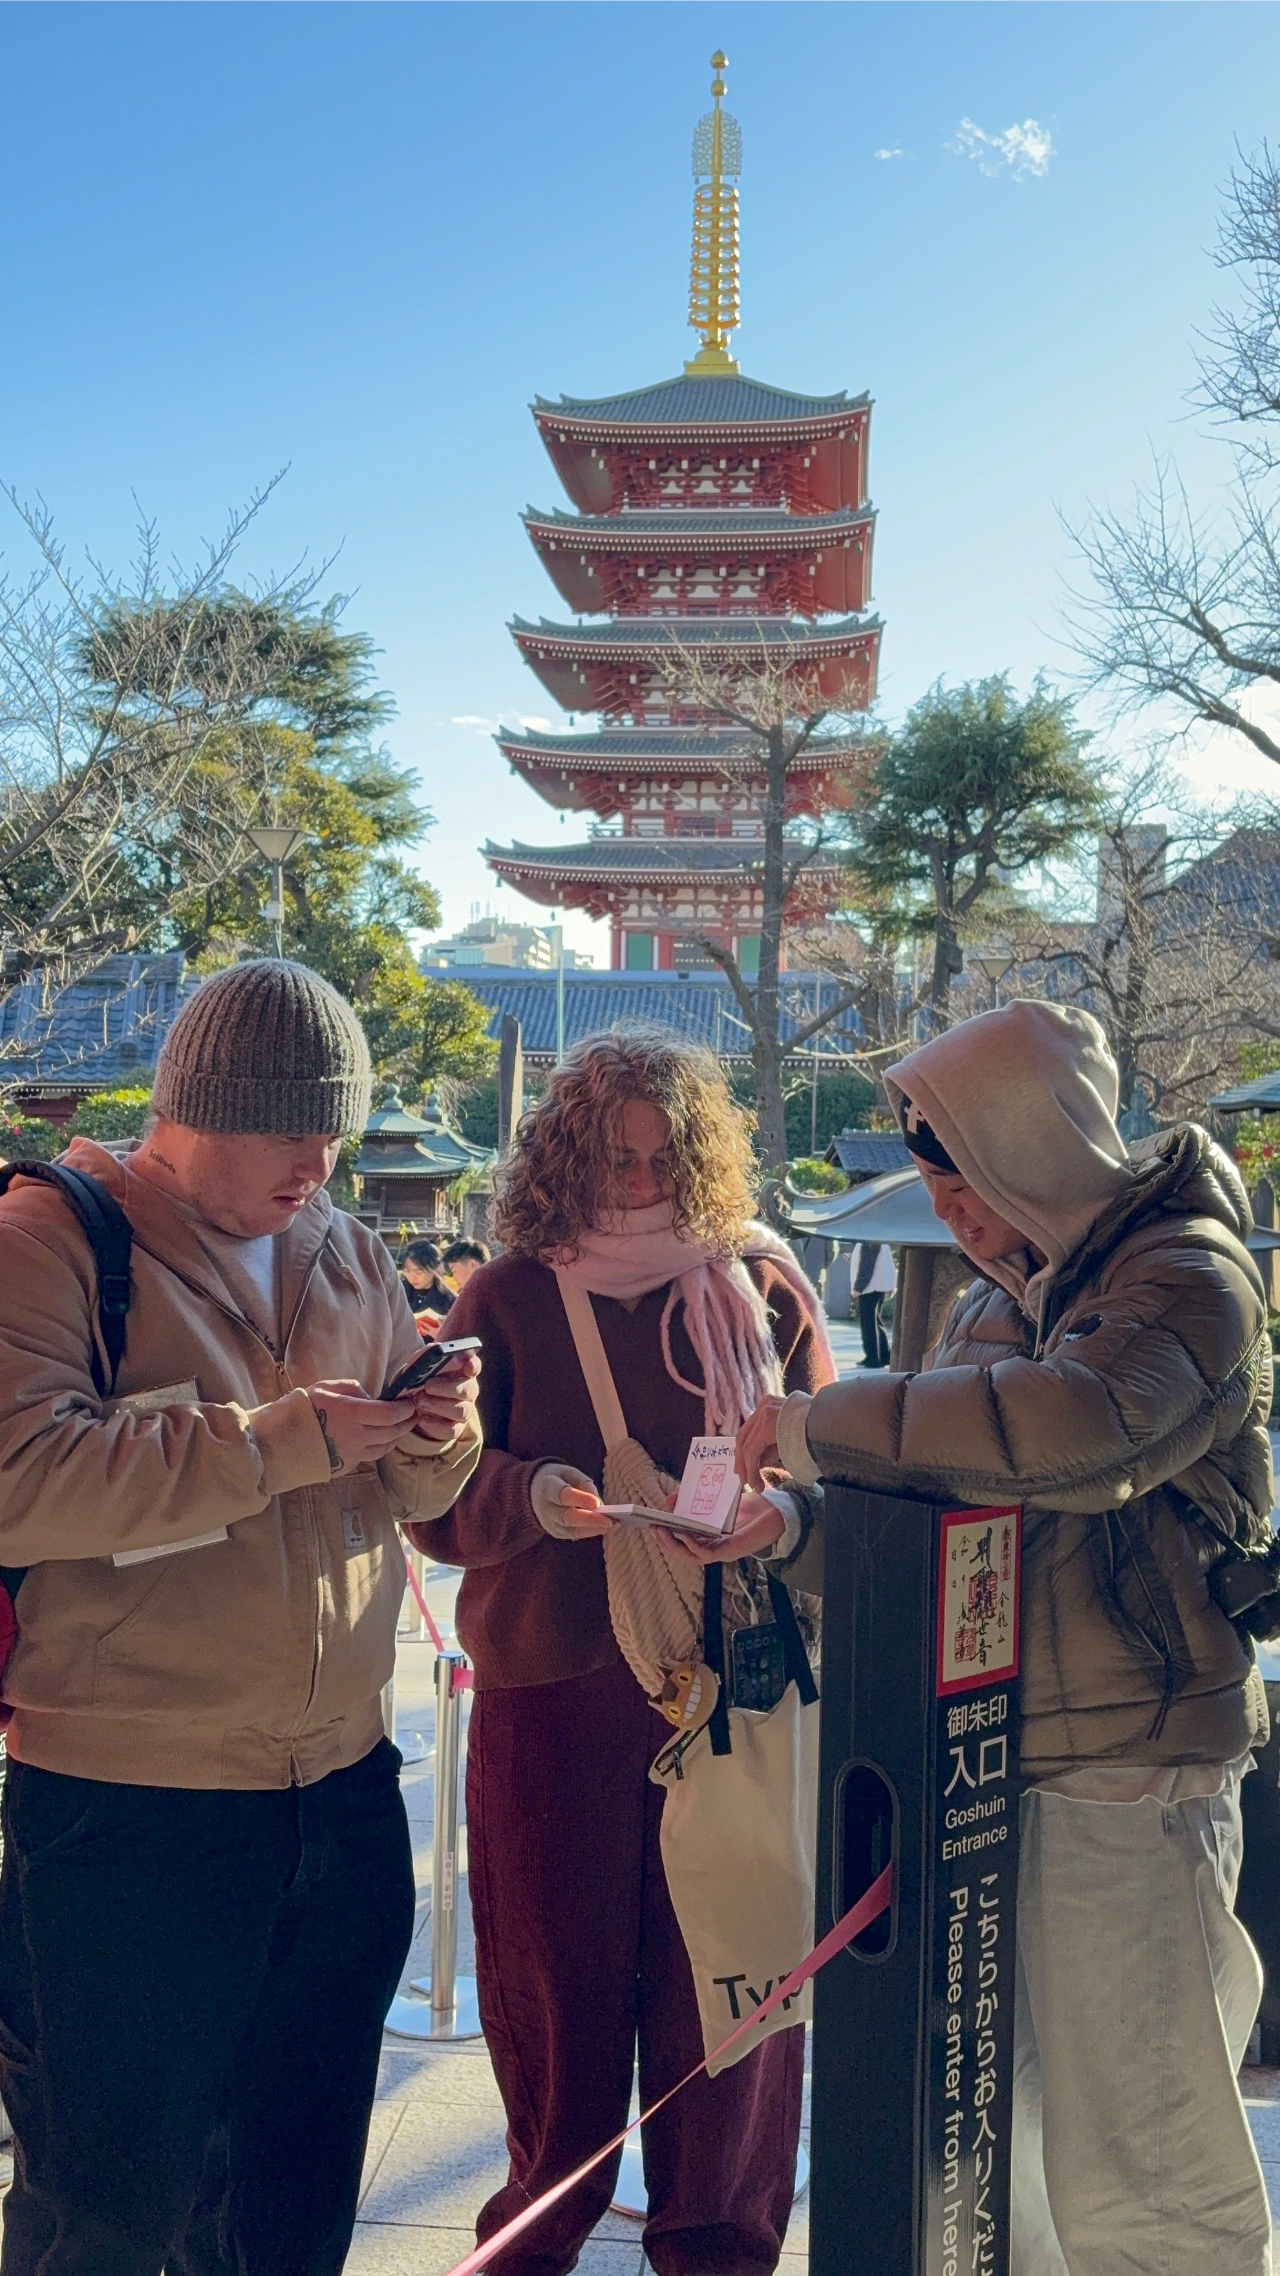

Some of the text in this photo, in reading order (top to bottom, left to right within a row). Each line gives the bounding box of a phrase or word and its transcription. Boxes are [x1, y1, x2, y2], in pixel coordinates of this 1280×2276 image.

[947, 1695, 1007, 1739] 御朱印
[943, 1735, 1007, 1797] 入口
[945, 1795, 1006, 1830] Goshuin
[942, 1825, 1007, 1861] Entrance
[942, 1886, 968, 2276] Please enter from here
[971, 1873, 999, 2276] こちらからお入りくだ
